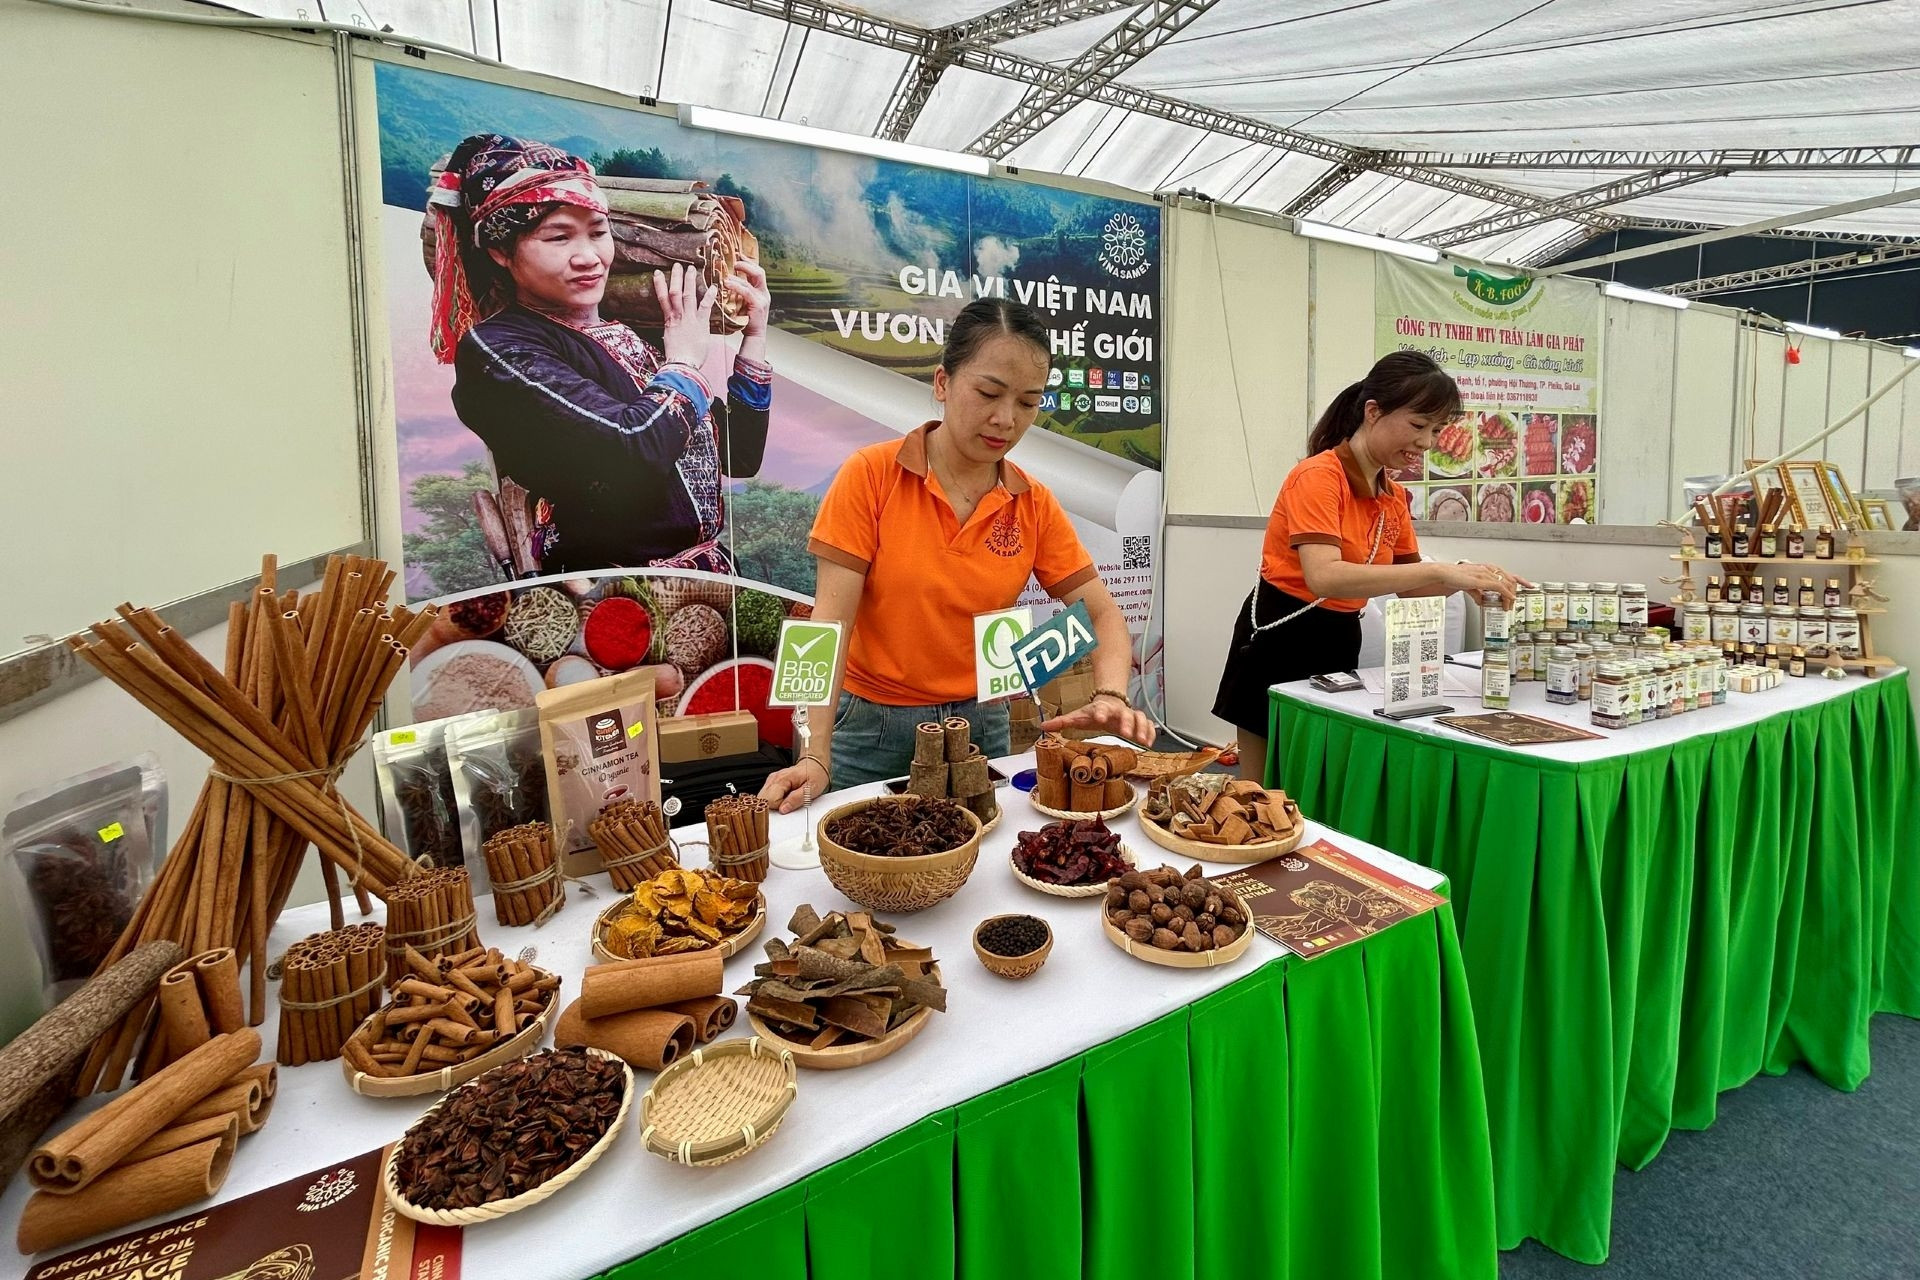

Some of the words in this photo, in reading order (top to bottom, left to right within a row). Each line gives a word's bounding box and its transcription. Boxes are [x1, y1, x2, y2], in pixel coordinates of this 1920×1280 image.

[1098, 252, 1152, 280] VINASAMEX
[899, 265, 963, 299] GIA
[1013, 275, 1077, 317] VIỆT
[1086, 288, 1152, 320] NAM
[830, 308, 944, 346] VƯƠN
[1046, 320, 1085, 357] HẾ
[1093, 328, 1153, 362] GIỚI
[1396, 315, 1424, 337] CÔNG
[1428, 321, 1442, 338] TY
[1444, 323, 1473, 341] TNHH
[1546, 334, 1560, 350] GIA
[1110, 577, 1122, 585] 246
[1123, 576, 1135, 584] 297
[1016, 614, 1094, 685] FDA
[783, 660, 829, 678] BRC
[989, 672, 1023, 694] BIO
[780, 677, 826, 692] FOOD
[582, 756, 625, 776] CINNAMON
[625, 751, 639, 762] TEA
[36, 1239, 144, 1280] ORGANIC
[146, 1216, 209, 1245] SPICE
[159, 1236, 195, 1256] OIL
[374, 1212, 396, 1267] ORGANIC
